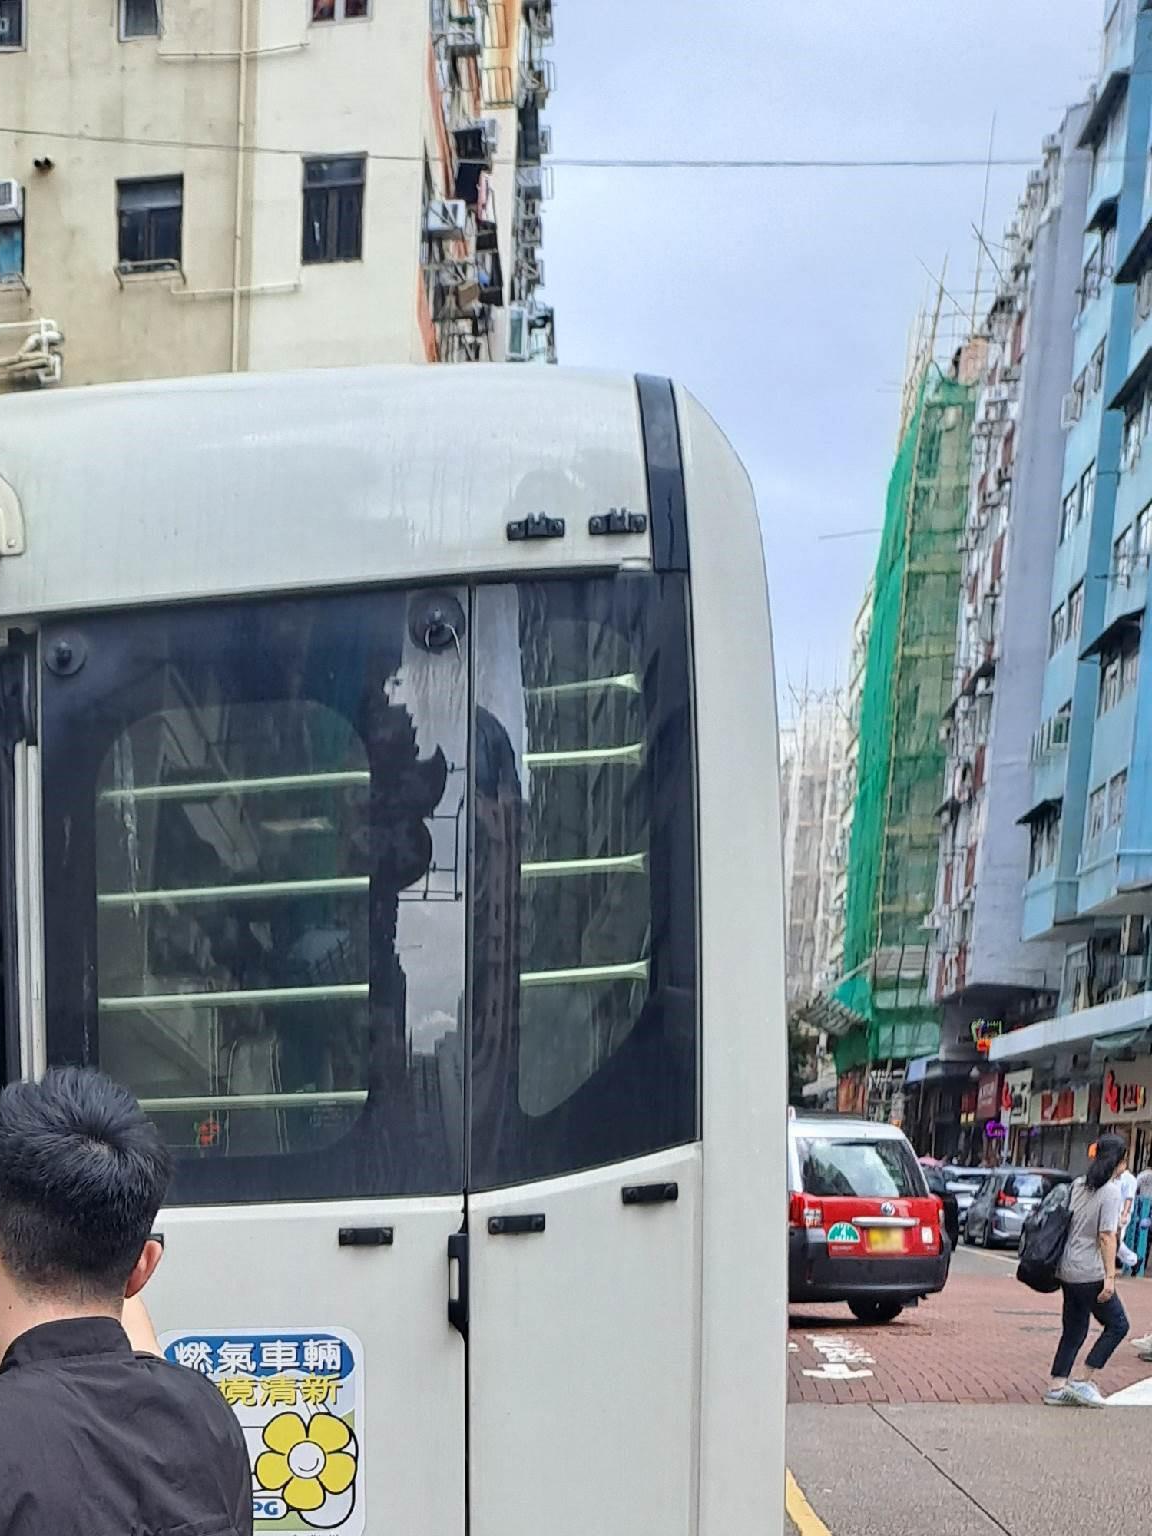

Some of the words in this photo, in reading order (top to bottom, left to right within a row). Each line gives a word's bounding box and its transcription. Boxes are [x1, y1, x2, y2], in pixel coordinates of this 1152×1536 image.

[174, 1339, 344, 1374] 燃氣車輛
[218, 1373, 344, 1407] 境清新
[253, 1500, 280, 1516] PG
